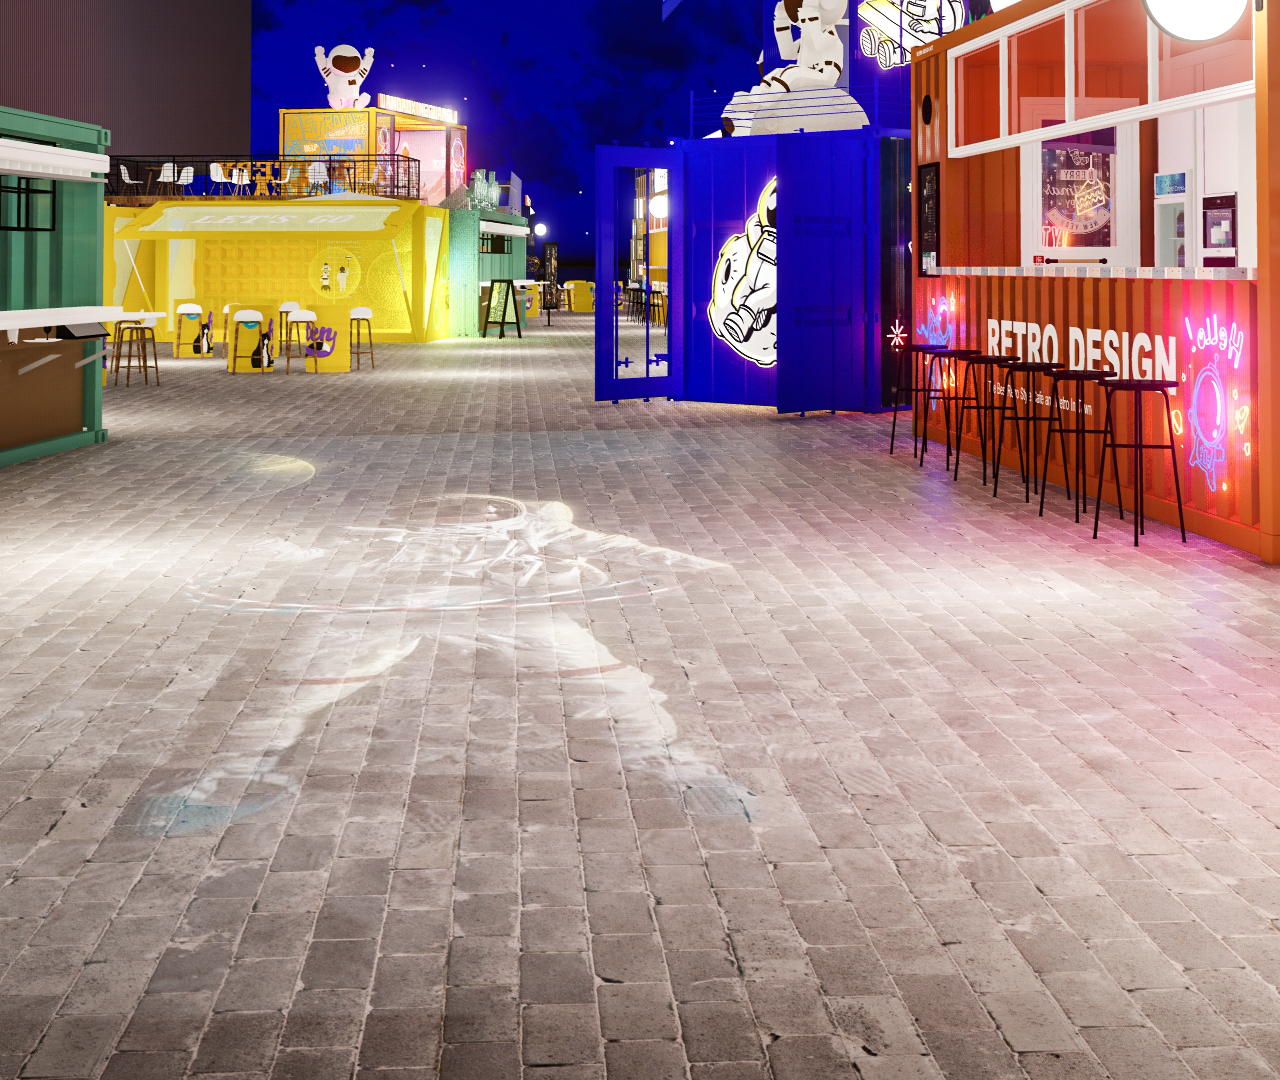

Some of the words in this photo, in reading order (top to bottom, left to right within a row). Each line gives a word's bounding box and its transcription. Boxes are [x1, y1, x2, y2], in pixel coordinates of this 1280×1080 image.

[190, 214, 298, 225] LET'S
[306, 214, 356, 225] GO
[987, 319, 1059, 371] RETRO
[1069, 326, 1177, 396] DESIGN
[988, 381, 997, 394] Te
[997, 383, 1006, 396] Bes
